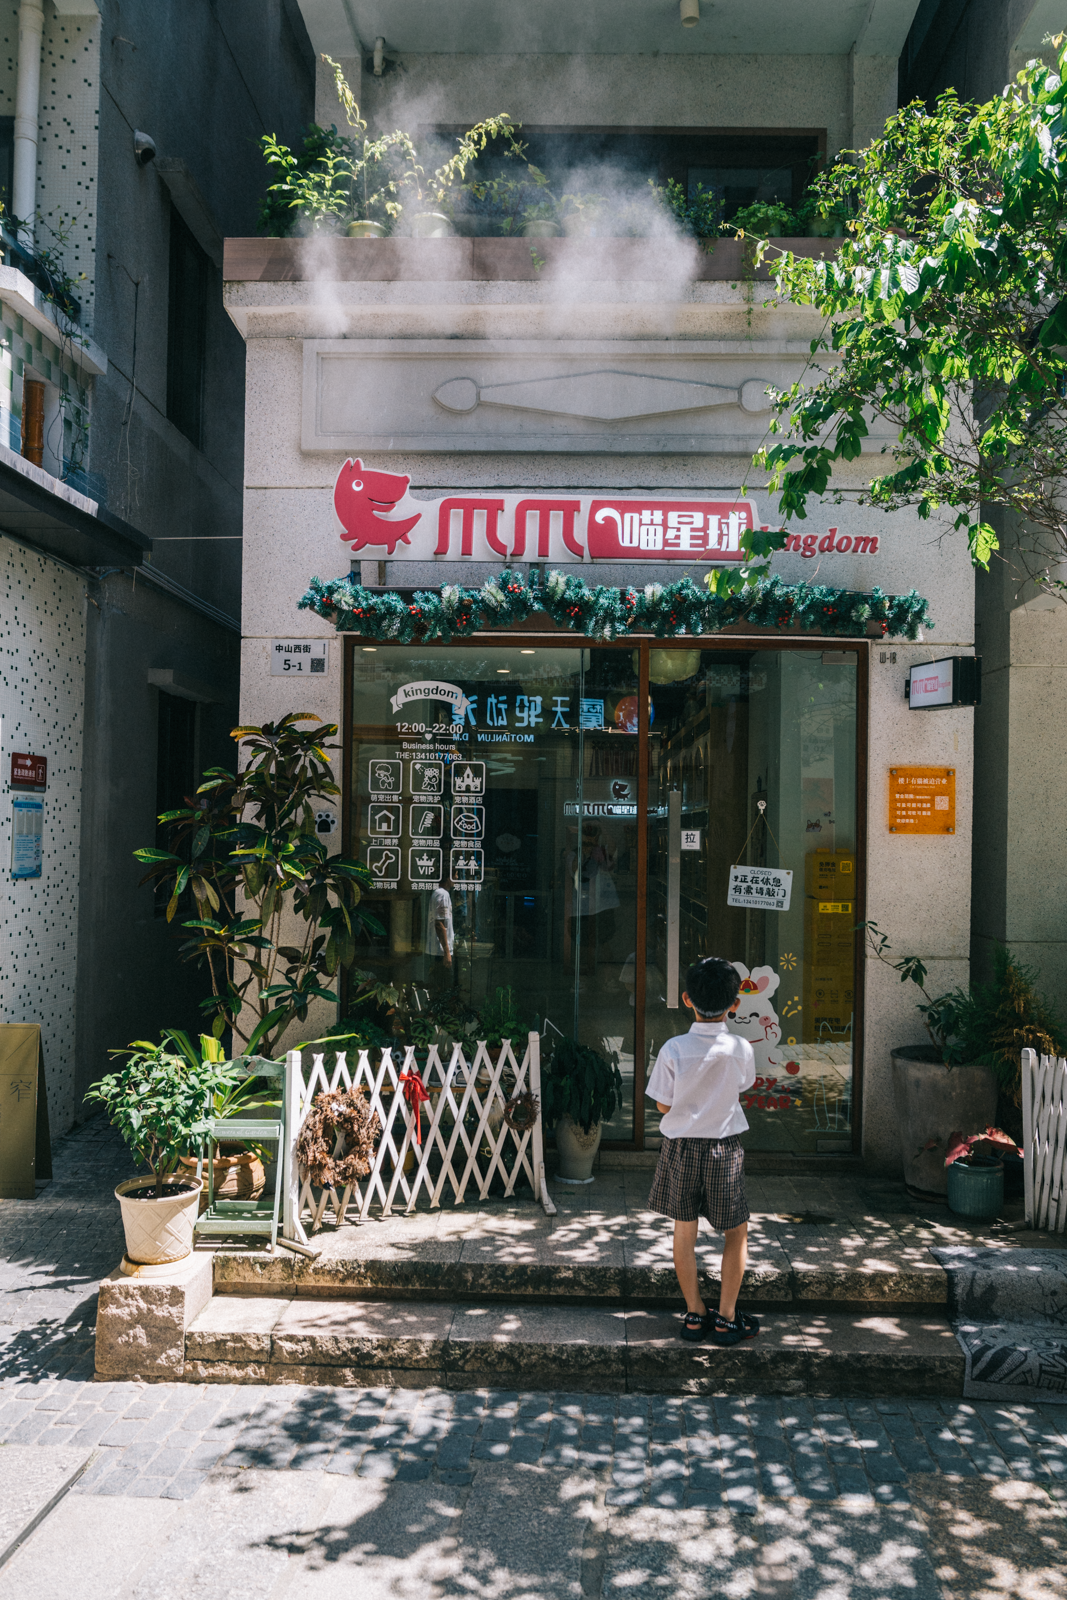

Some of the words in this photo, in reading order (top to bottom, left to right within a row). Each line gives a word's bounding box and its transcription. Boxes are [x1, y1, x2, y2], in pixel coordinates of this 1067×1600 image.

[760, 526, 879, 559] ngdom
[275, 644, 311, 653] 中山西街
[283, 659, 303, 671] 5-1
[403, 685, 459, 700] kingdom
[402, 742, 434, 750] Business
[435, 742, 456, 751] hours
[412, 795, 441, 803] 宠物洗护
[411, 839, 440, 847] 宠物用品
[685, 832, 696, 843] 拉
[453, 840, 482, 848] 宠物食品
[418, 866, 435, 875] VIP
[738, 874, 782, 888] 正在休息
[732, 885, 787, 898] 有需请敲门
[10, 1079, 32, 1103] 窄
[743, 1094, 791, 1109] YEAR
